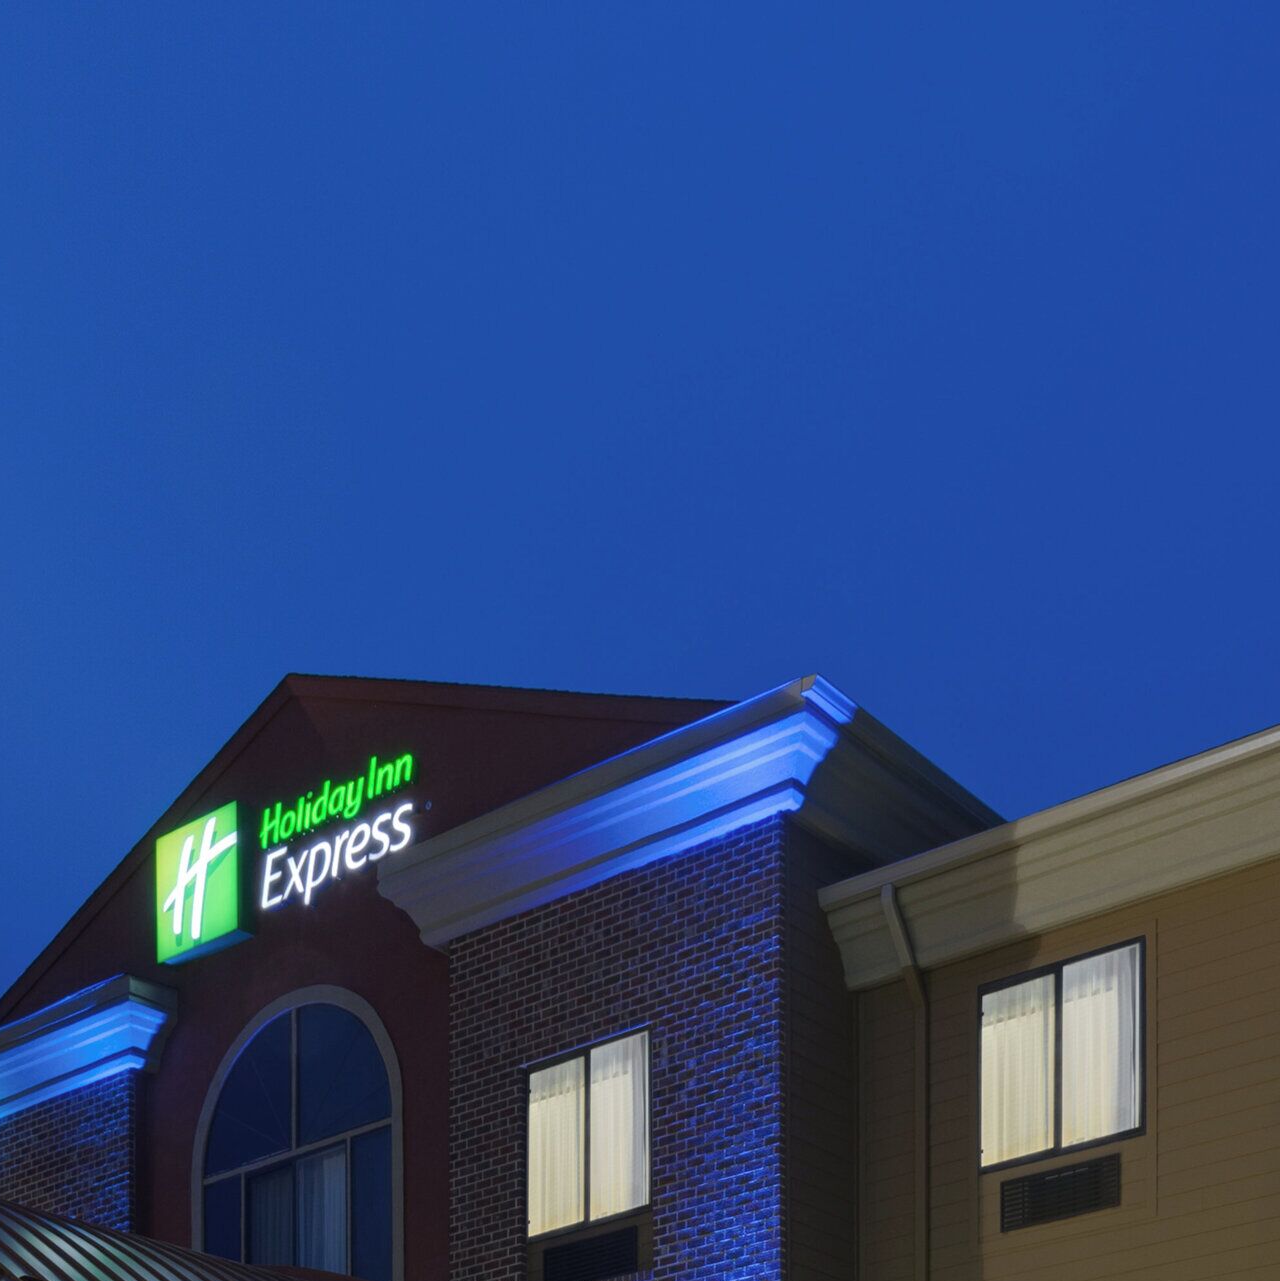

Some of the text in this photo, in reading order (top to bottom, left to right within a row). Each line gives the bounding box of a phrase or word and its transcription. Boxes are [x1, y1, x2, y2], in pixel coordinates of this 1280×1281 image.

[260, 754, 413, 849] Holiday Inn
[261, 803, 413, 909] Express
